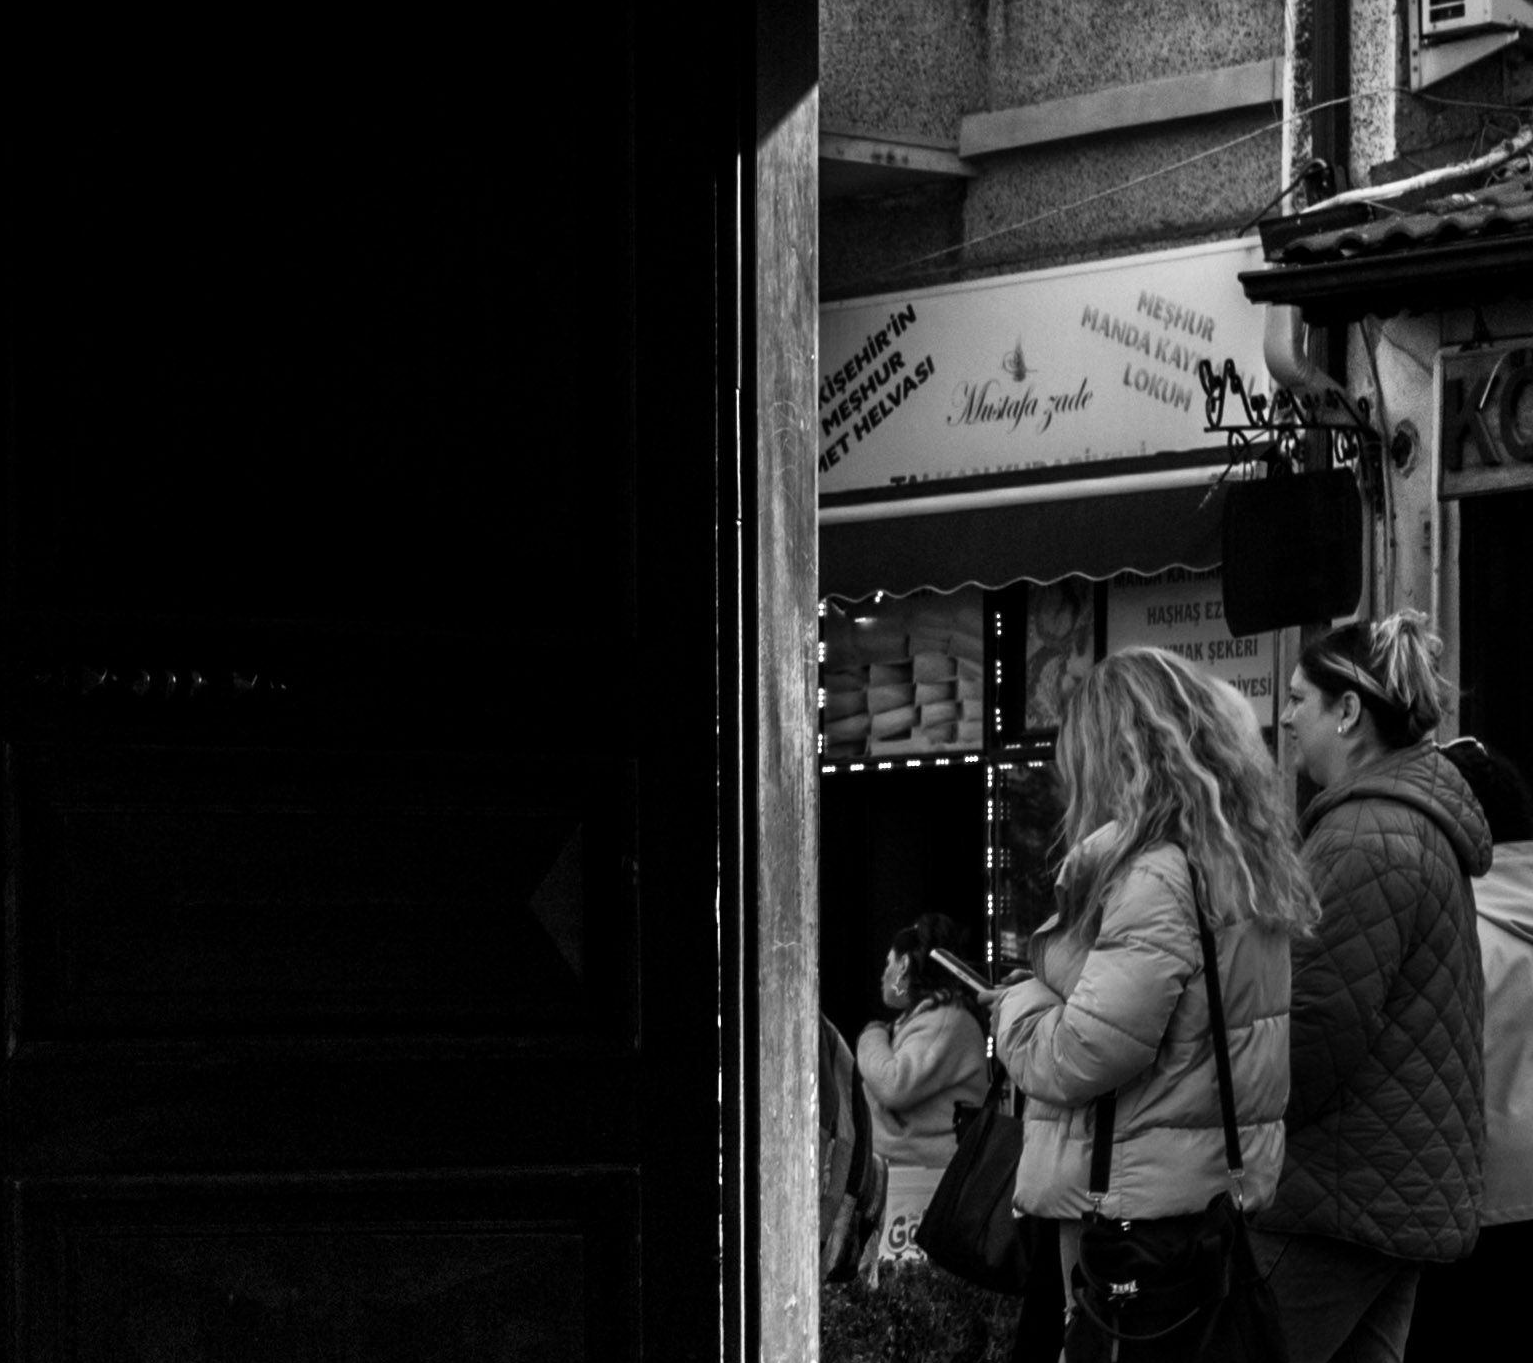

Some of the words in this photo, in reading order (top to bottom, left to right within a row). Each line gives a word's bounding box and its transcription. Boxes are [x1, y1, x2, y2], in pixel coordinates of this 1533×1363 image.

[1080, 304, 1151, 357] MANDA
[1137, 290, 1215, 343] MEŞHUR
[821, 351, 906, 437] MEŞHUR
[854, 355, 935, 441] HELVASI
[1123, 362, 1193, 413] LOKUM
[1147, 602, 1200, 628] HAŞHAŞ
